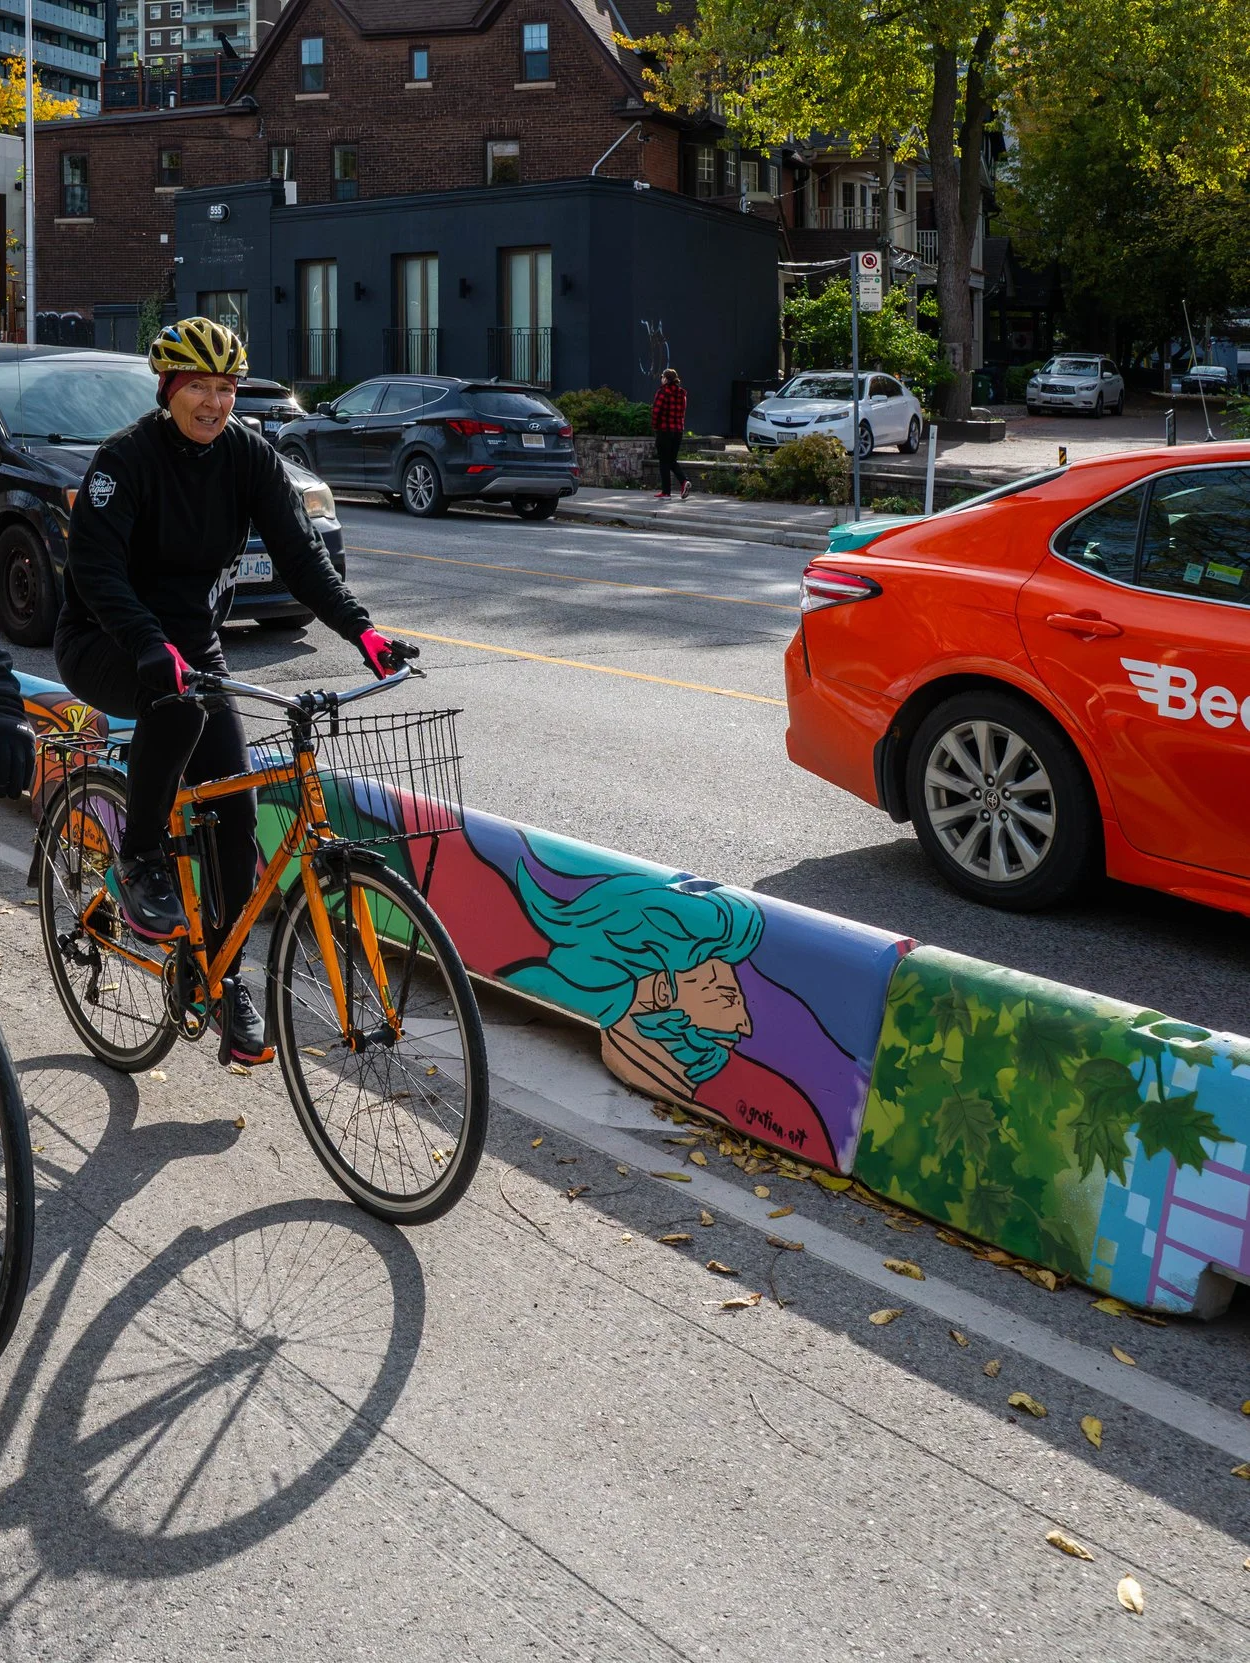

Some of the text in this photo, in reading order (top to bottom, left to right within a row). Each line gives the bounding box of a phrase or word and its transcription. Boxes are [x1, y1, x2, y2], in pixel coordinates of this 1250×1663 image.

[210, 205, 222, 215] 555
[219, 314, 238, 329] 555
[254, 561, 271, 576] 405
